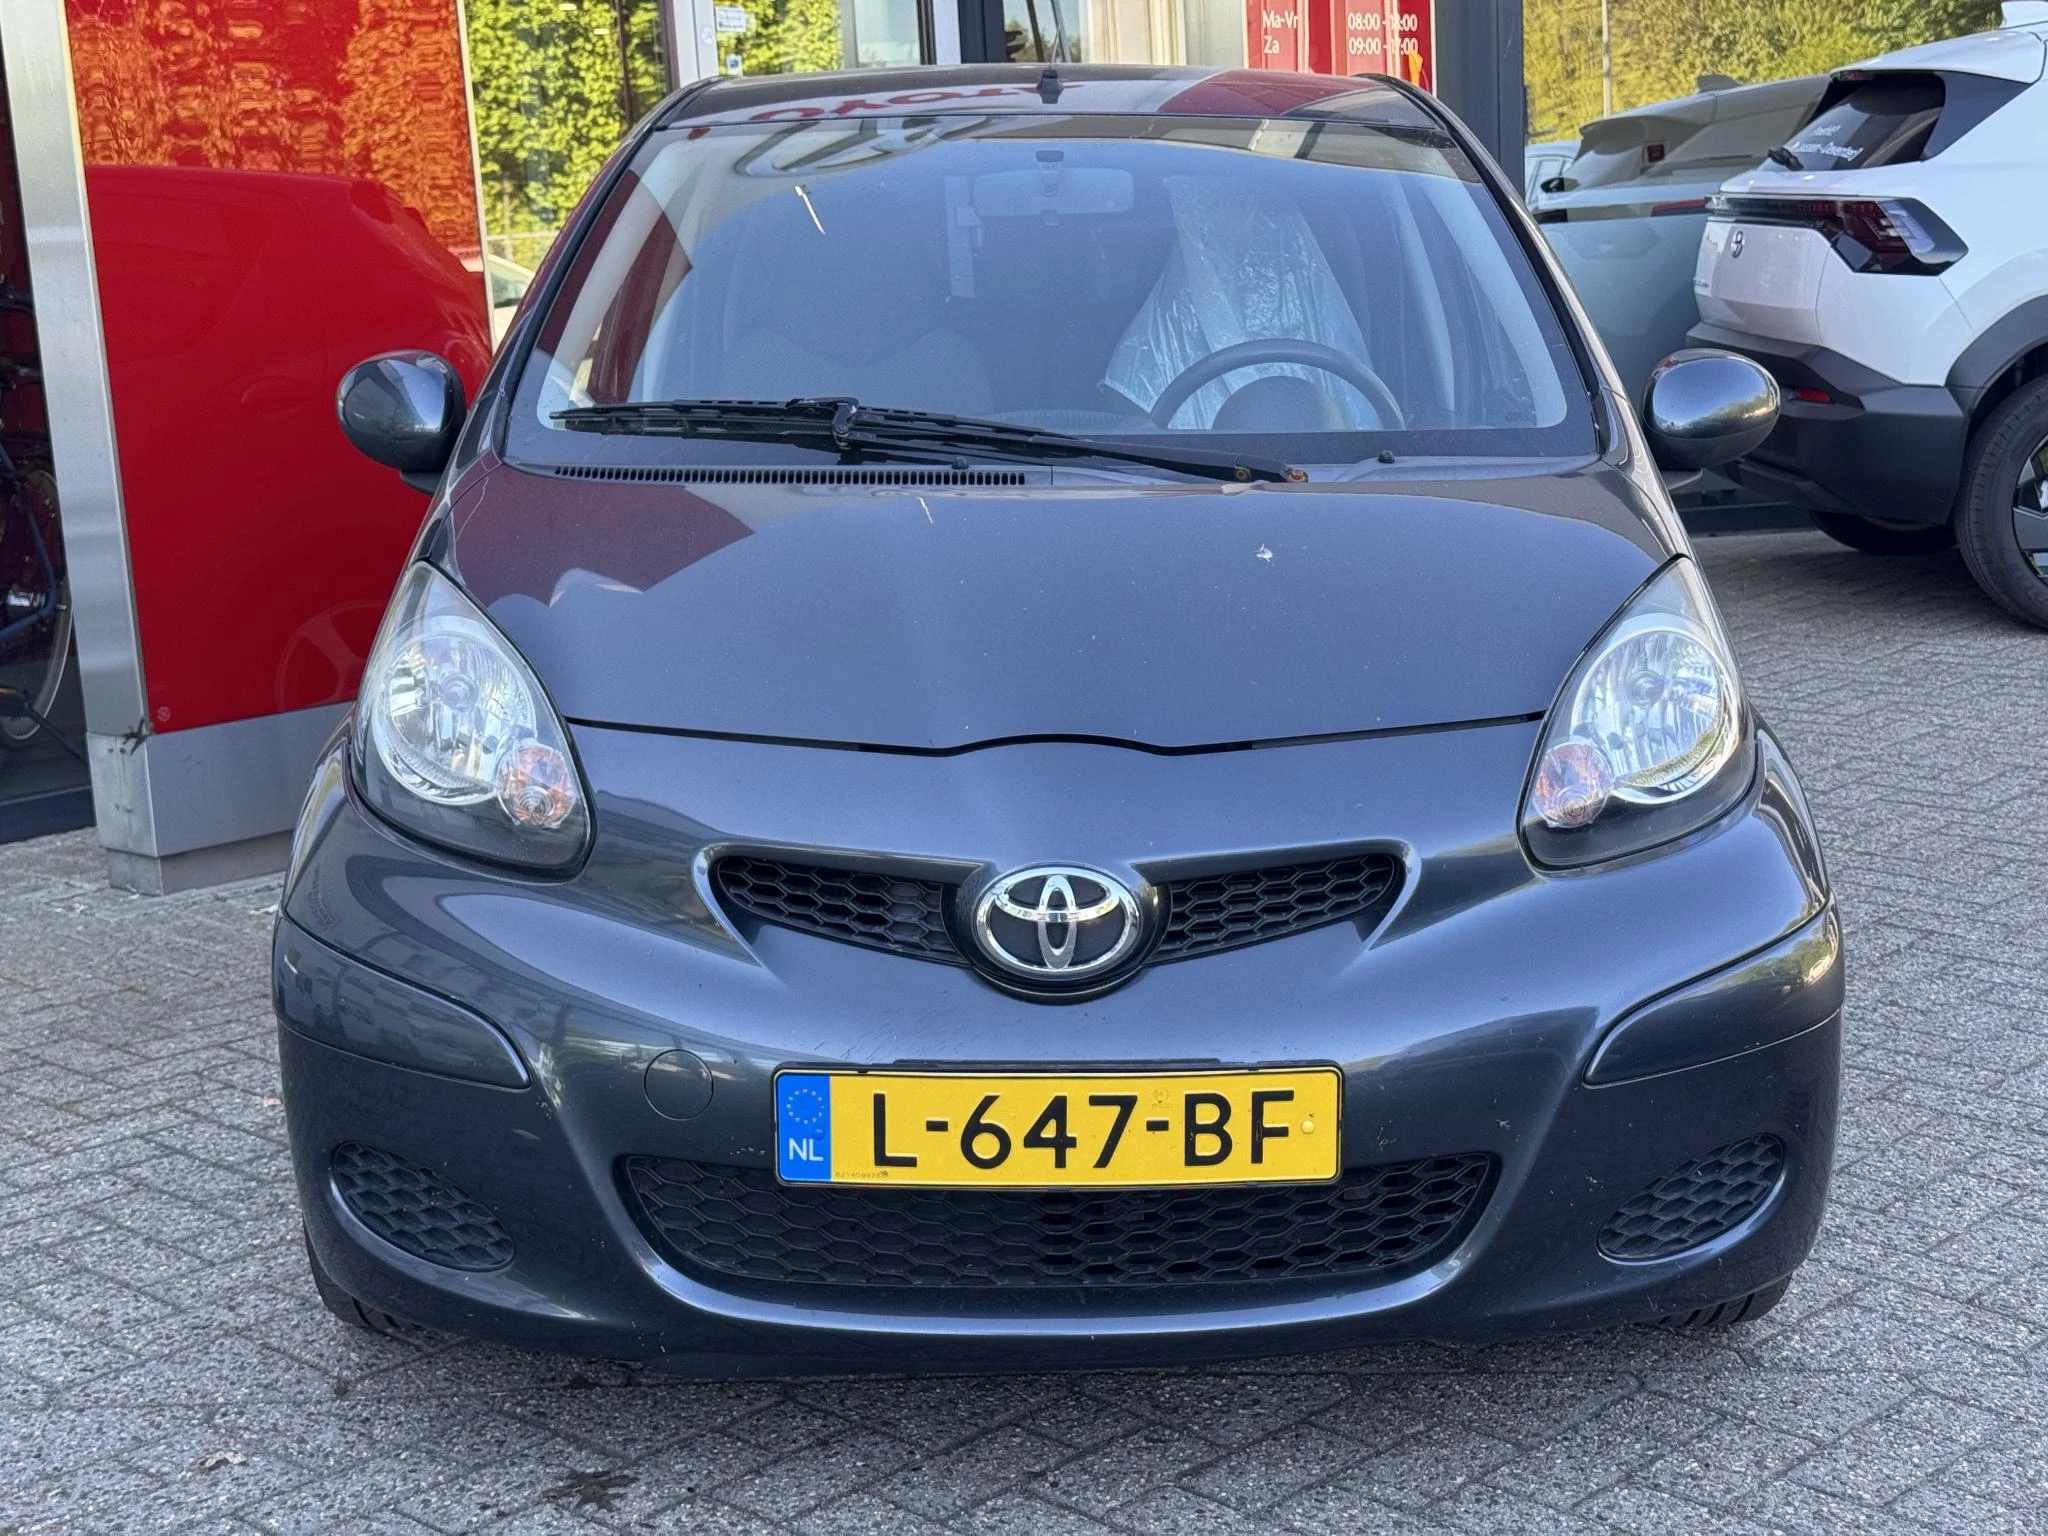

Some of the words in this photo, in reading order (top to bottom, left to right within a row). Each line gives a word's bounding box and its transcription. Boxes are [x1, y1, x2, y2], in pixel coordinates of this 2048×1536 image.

[1262, 11, 1298, 29] Ma-Vr
[1348, 13, 1380, 31] 08:00
[1264, 35, 1280, 54] Za
[1349, 37, 1381, 55] 09:00
[873, 1089, 1294, 1169] L-647-BF
[788, 1138, 824, 1161] NL
